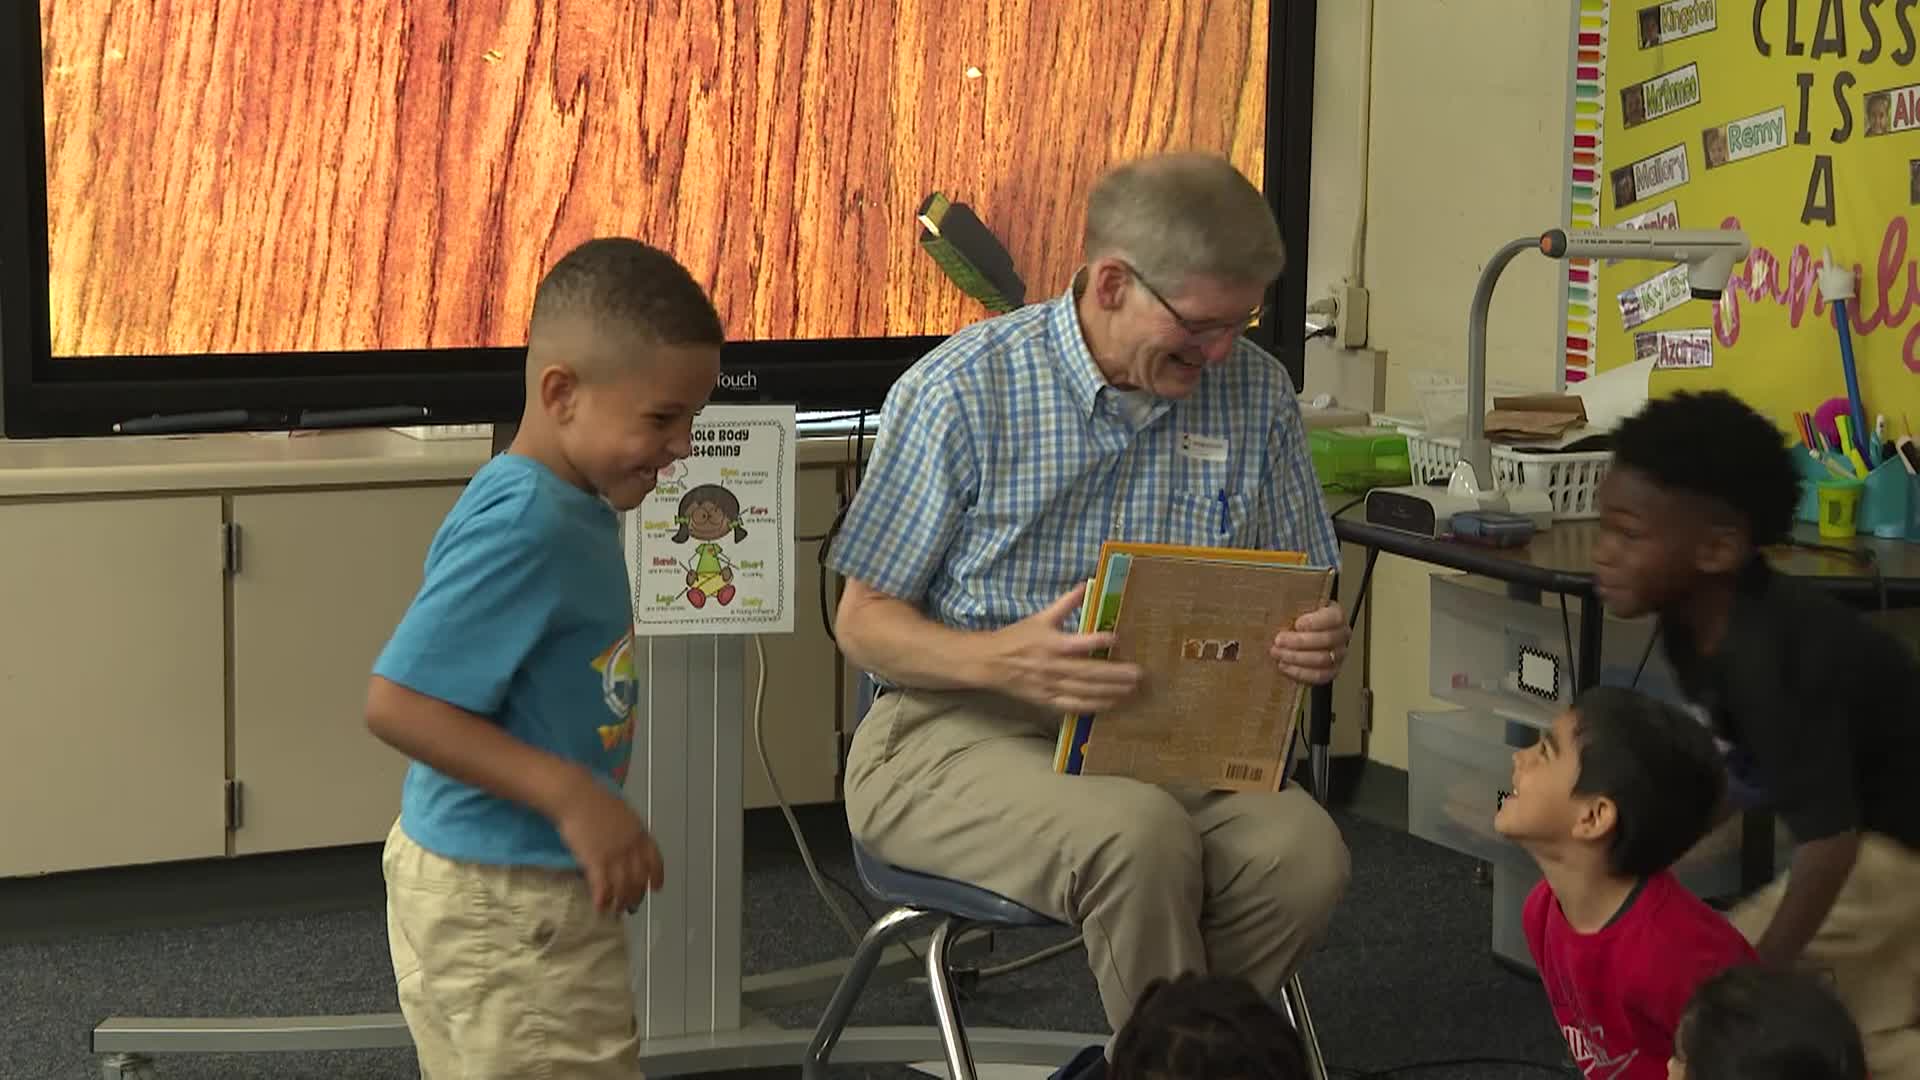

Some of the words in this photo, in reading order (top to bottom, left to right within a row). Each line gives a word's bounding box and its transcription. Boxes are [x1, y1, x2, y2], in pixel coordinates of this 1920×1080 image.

[1753, 0, 1917, 66] CLASS
[1728, 116, 1783, 152] Remy
[1794, 71, 1856, 144] IS
[1635, 152, 1686, 192] Mallory
[1801, 155, 1836, 227] A
